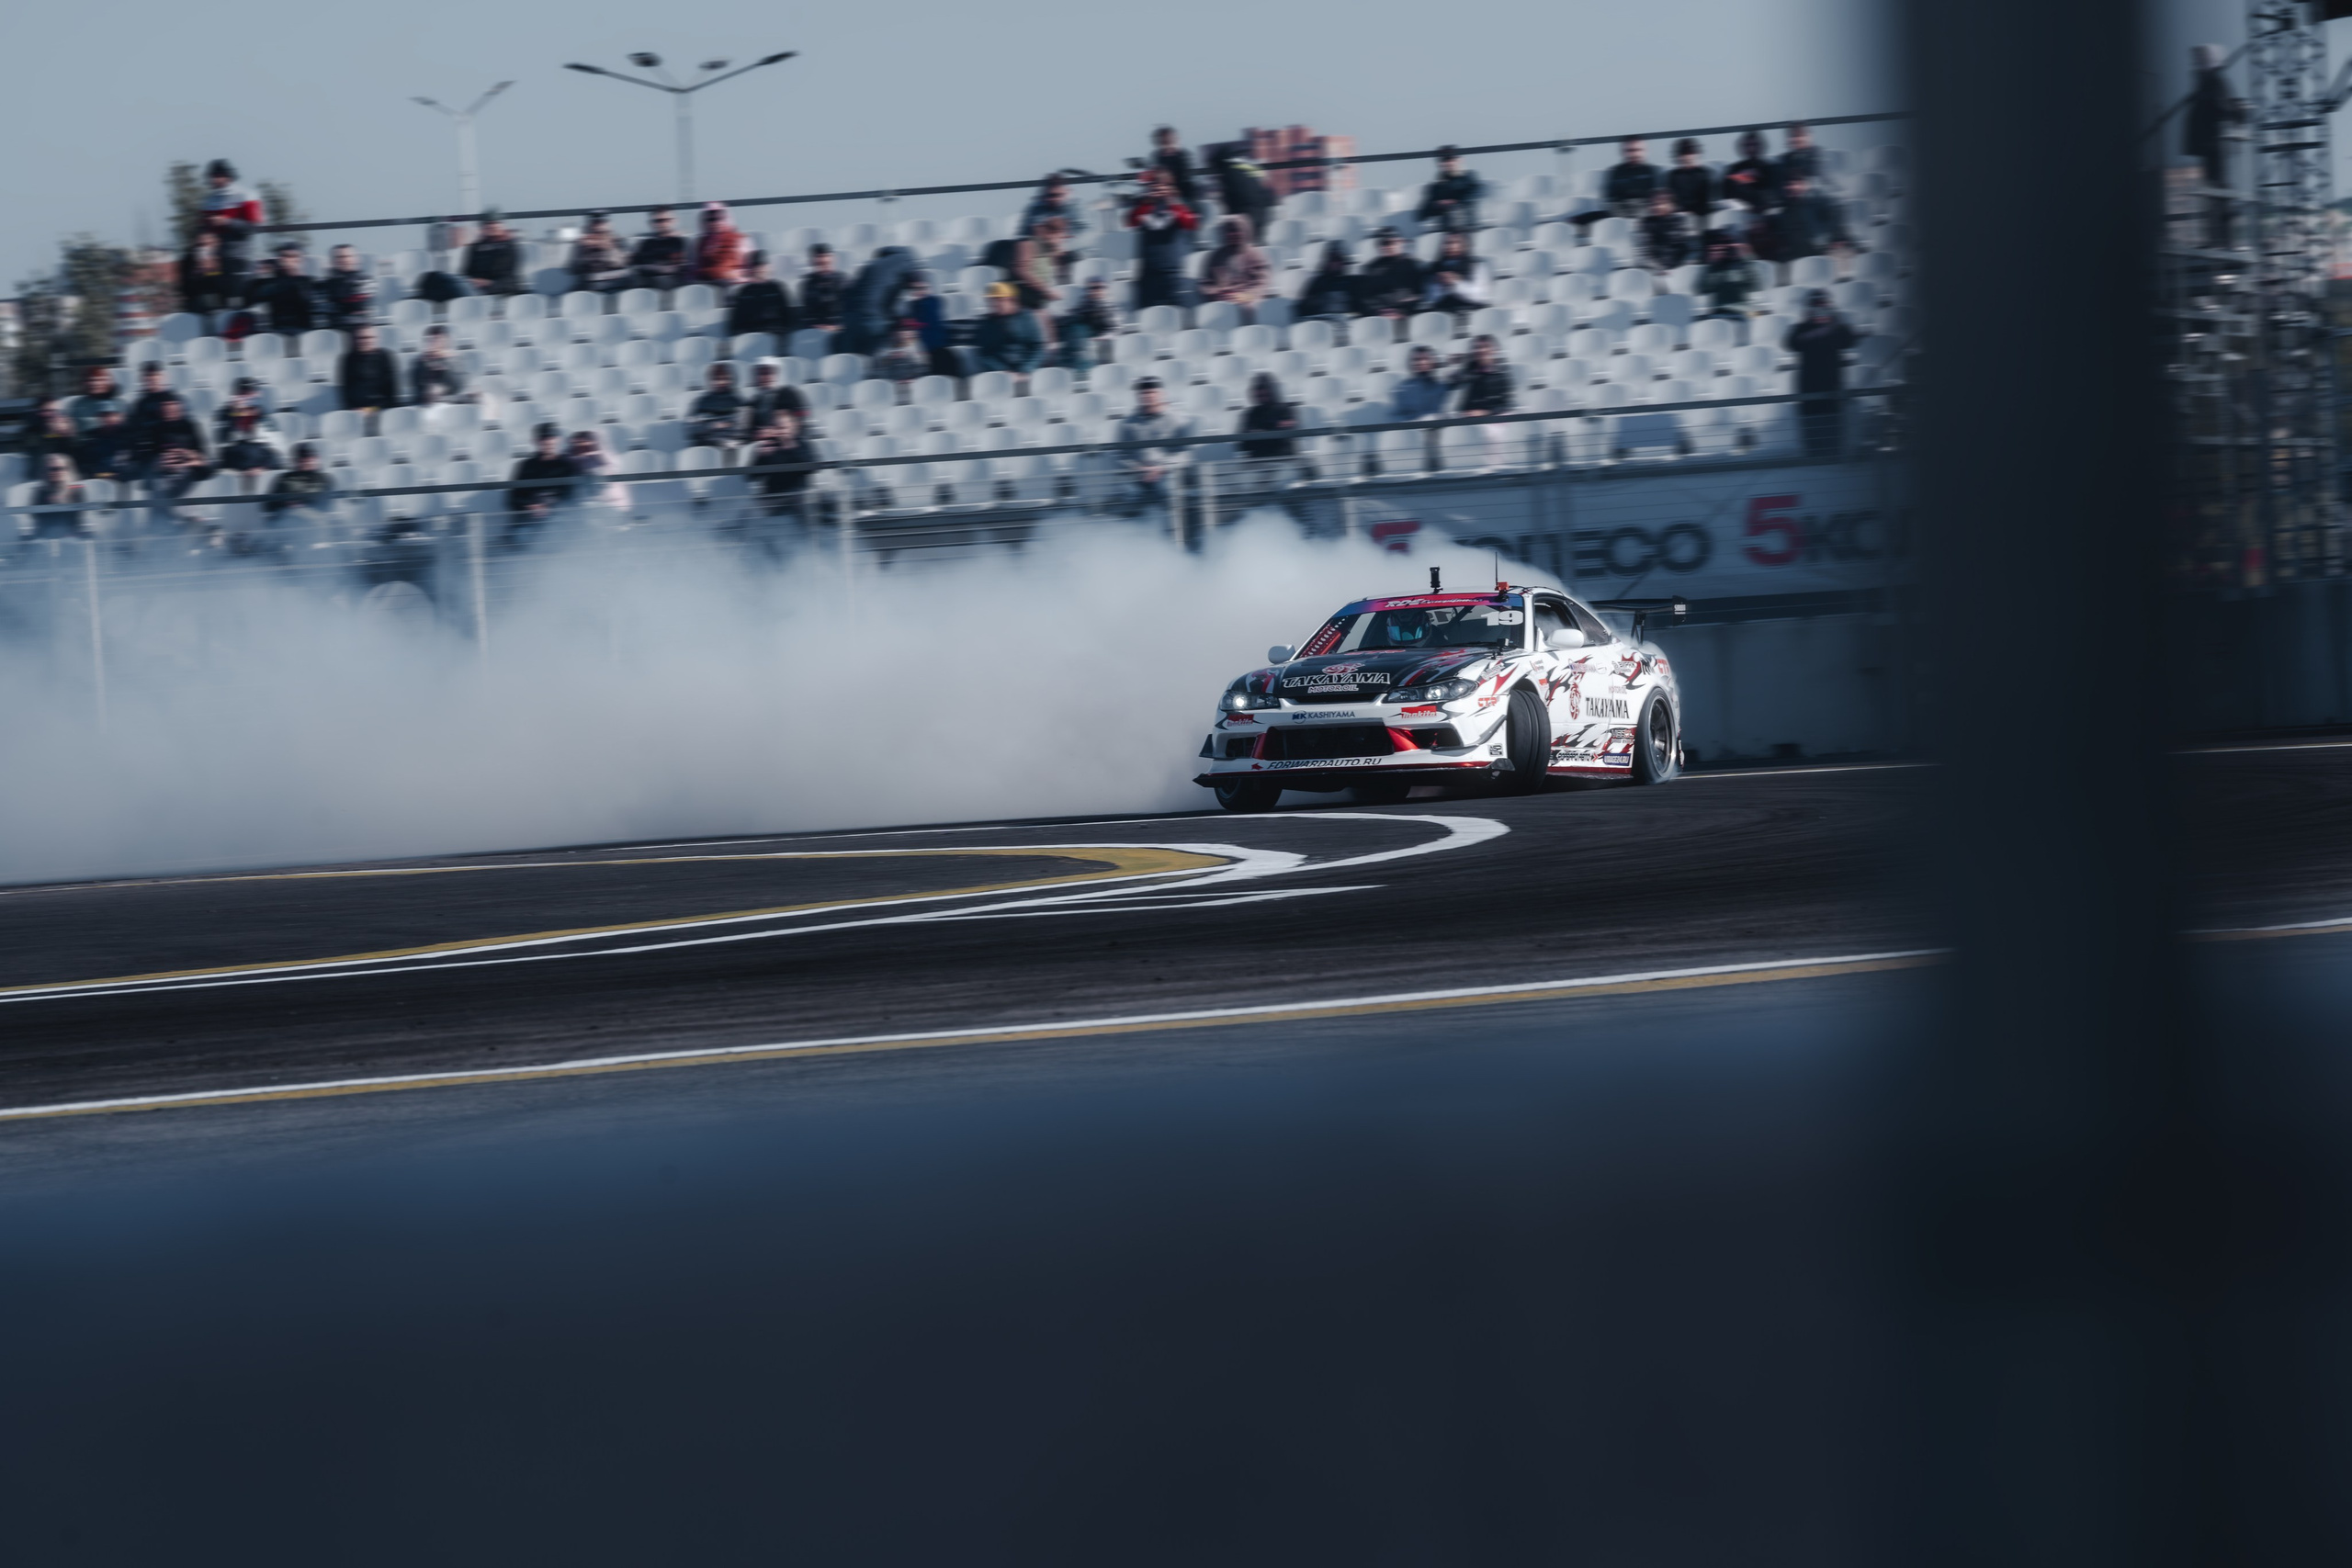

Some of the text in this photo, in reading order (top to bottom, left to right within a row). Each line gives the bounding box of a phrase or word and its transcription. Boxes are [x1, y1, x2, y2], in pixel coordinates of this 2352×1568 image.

[1480, 610, 1524, 626] 19
[1282, 672, 1391, 688] TAKAYAMA
[1307, 685, 1341, 694] MOTOR
[1401, 710, 1437, 718] makita
[1586, 697, 1630, 719] TAKAYAMA
[1267, 758, 1382, 770] FORWARDAUTO.RU
